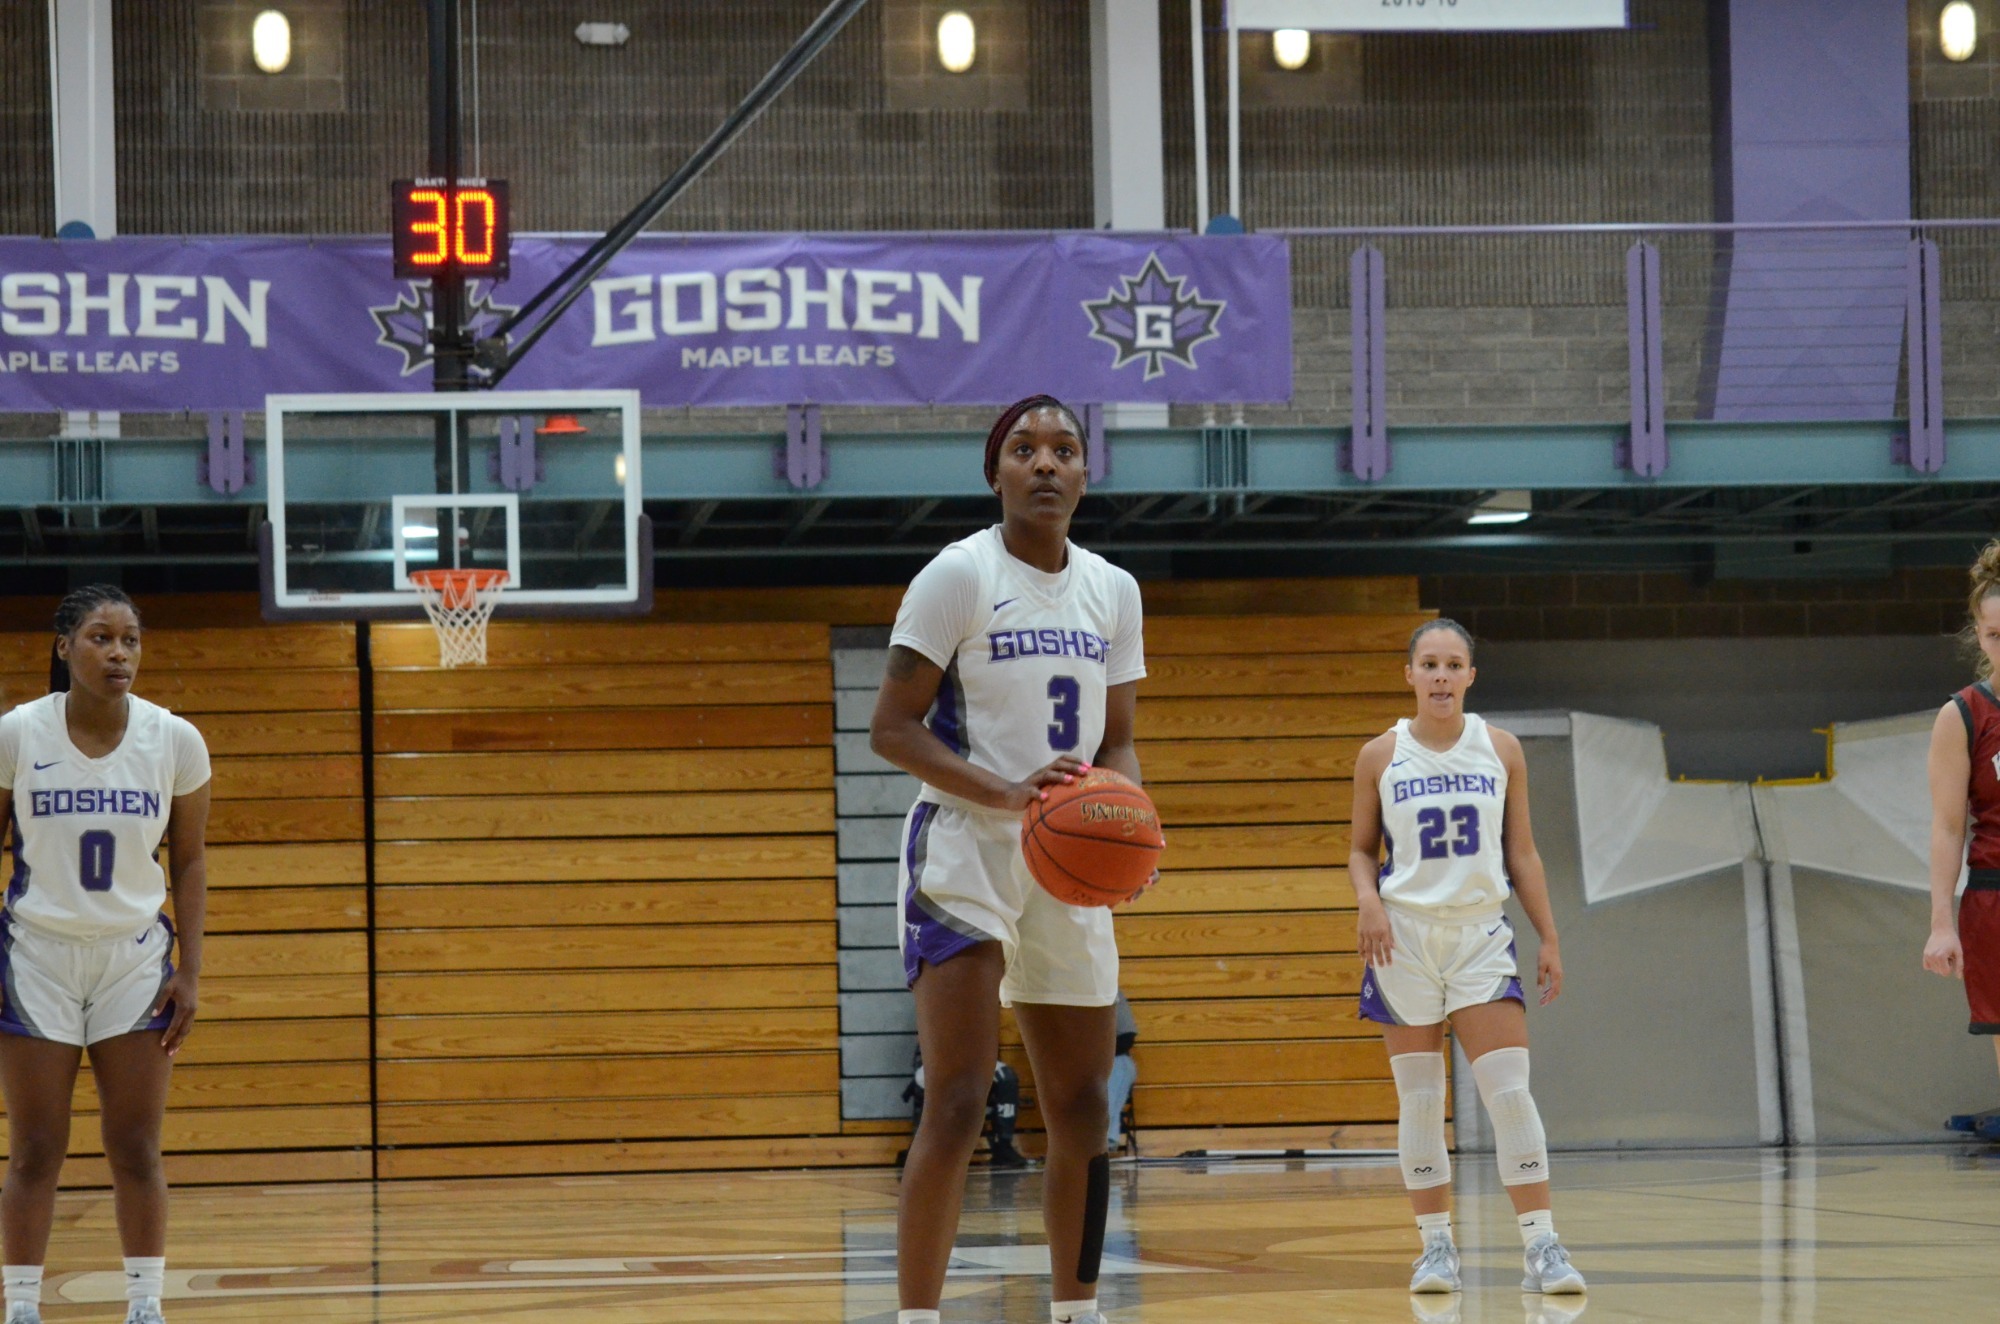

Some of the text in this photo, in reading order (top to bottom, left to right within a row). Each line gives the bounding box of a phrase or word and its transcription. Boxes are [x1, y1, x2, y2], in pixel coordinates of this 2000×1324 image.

[410, 190, 494, 264] 30
[590, 267, 984, 346] GOSHEN
[1135, 305, 1174, 348] G
[77, 351, 180, 373] LEAFS
[681, 344, 896, 368] MAPLE LEAFS
[1047, 674, 1081, 752] 3
[29, 787, 162, 820] GOSHEN
[1393, 773, 1497, 805] GOSHEN
[1417, 804, 1481, 860] 23
[78, 829, 117, 892] 0
